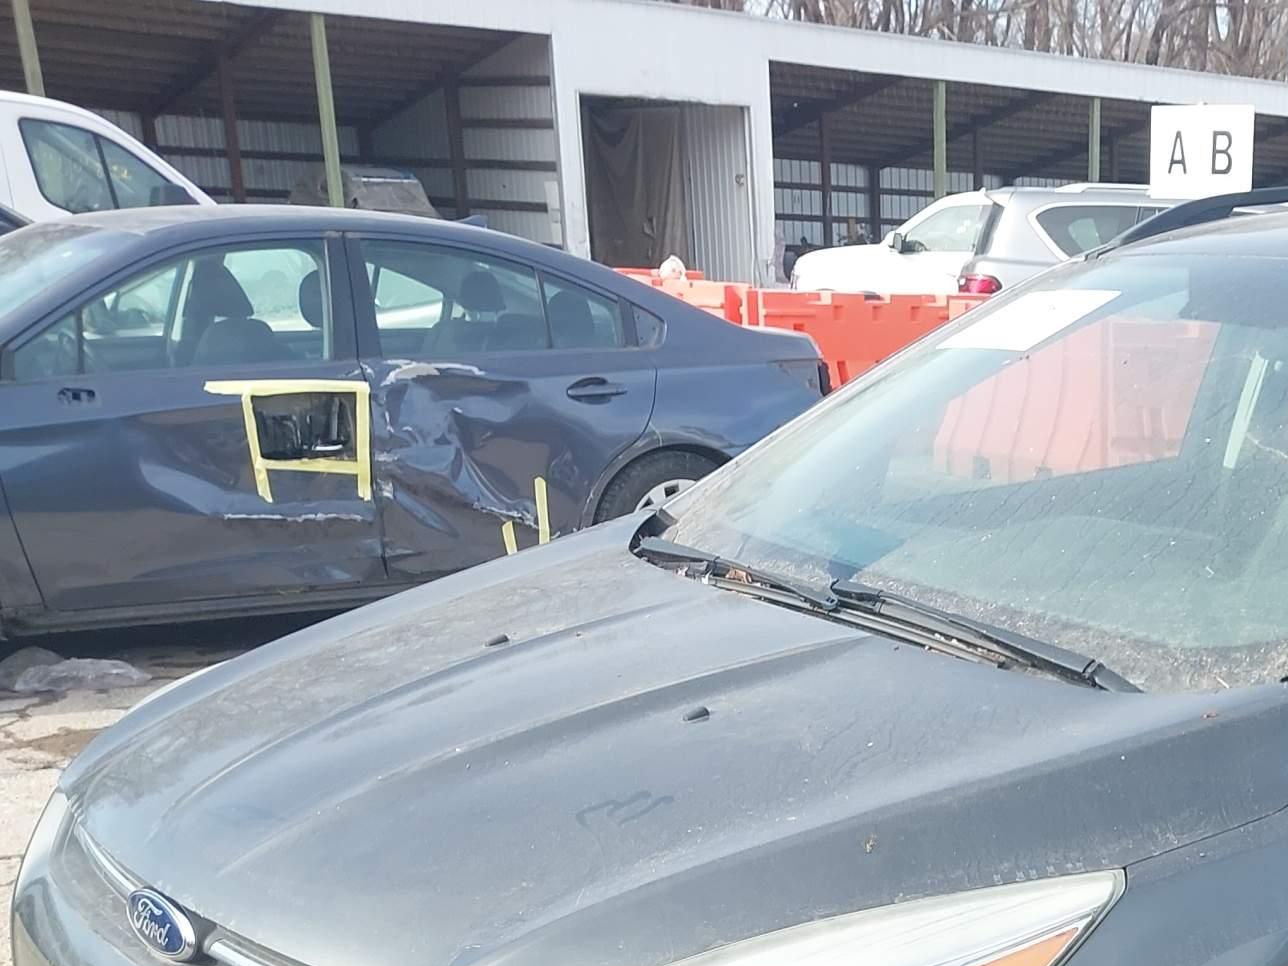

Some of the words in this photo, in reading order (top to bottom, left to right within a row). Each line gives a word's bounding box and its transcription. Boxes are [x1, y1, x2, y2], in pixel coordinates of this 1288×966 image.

[1168, 130, 1187, 175] A
[1211, 130, 1233, 175] B
[133, 897, 171, 946] Ford
